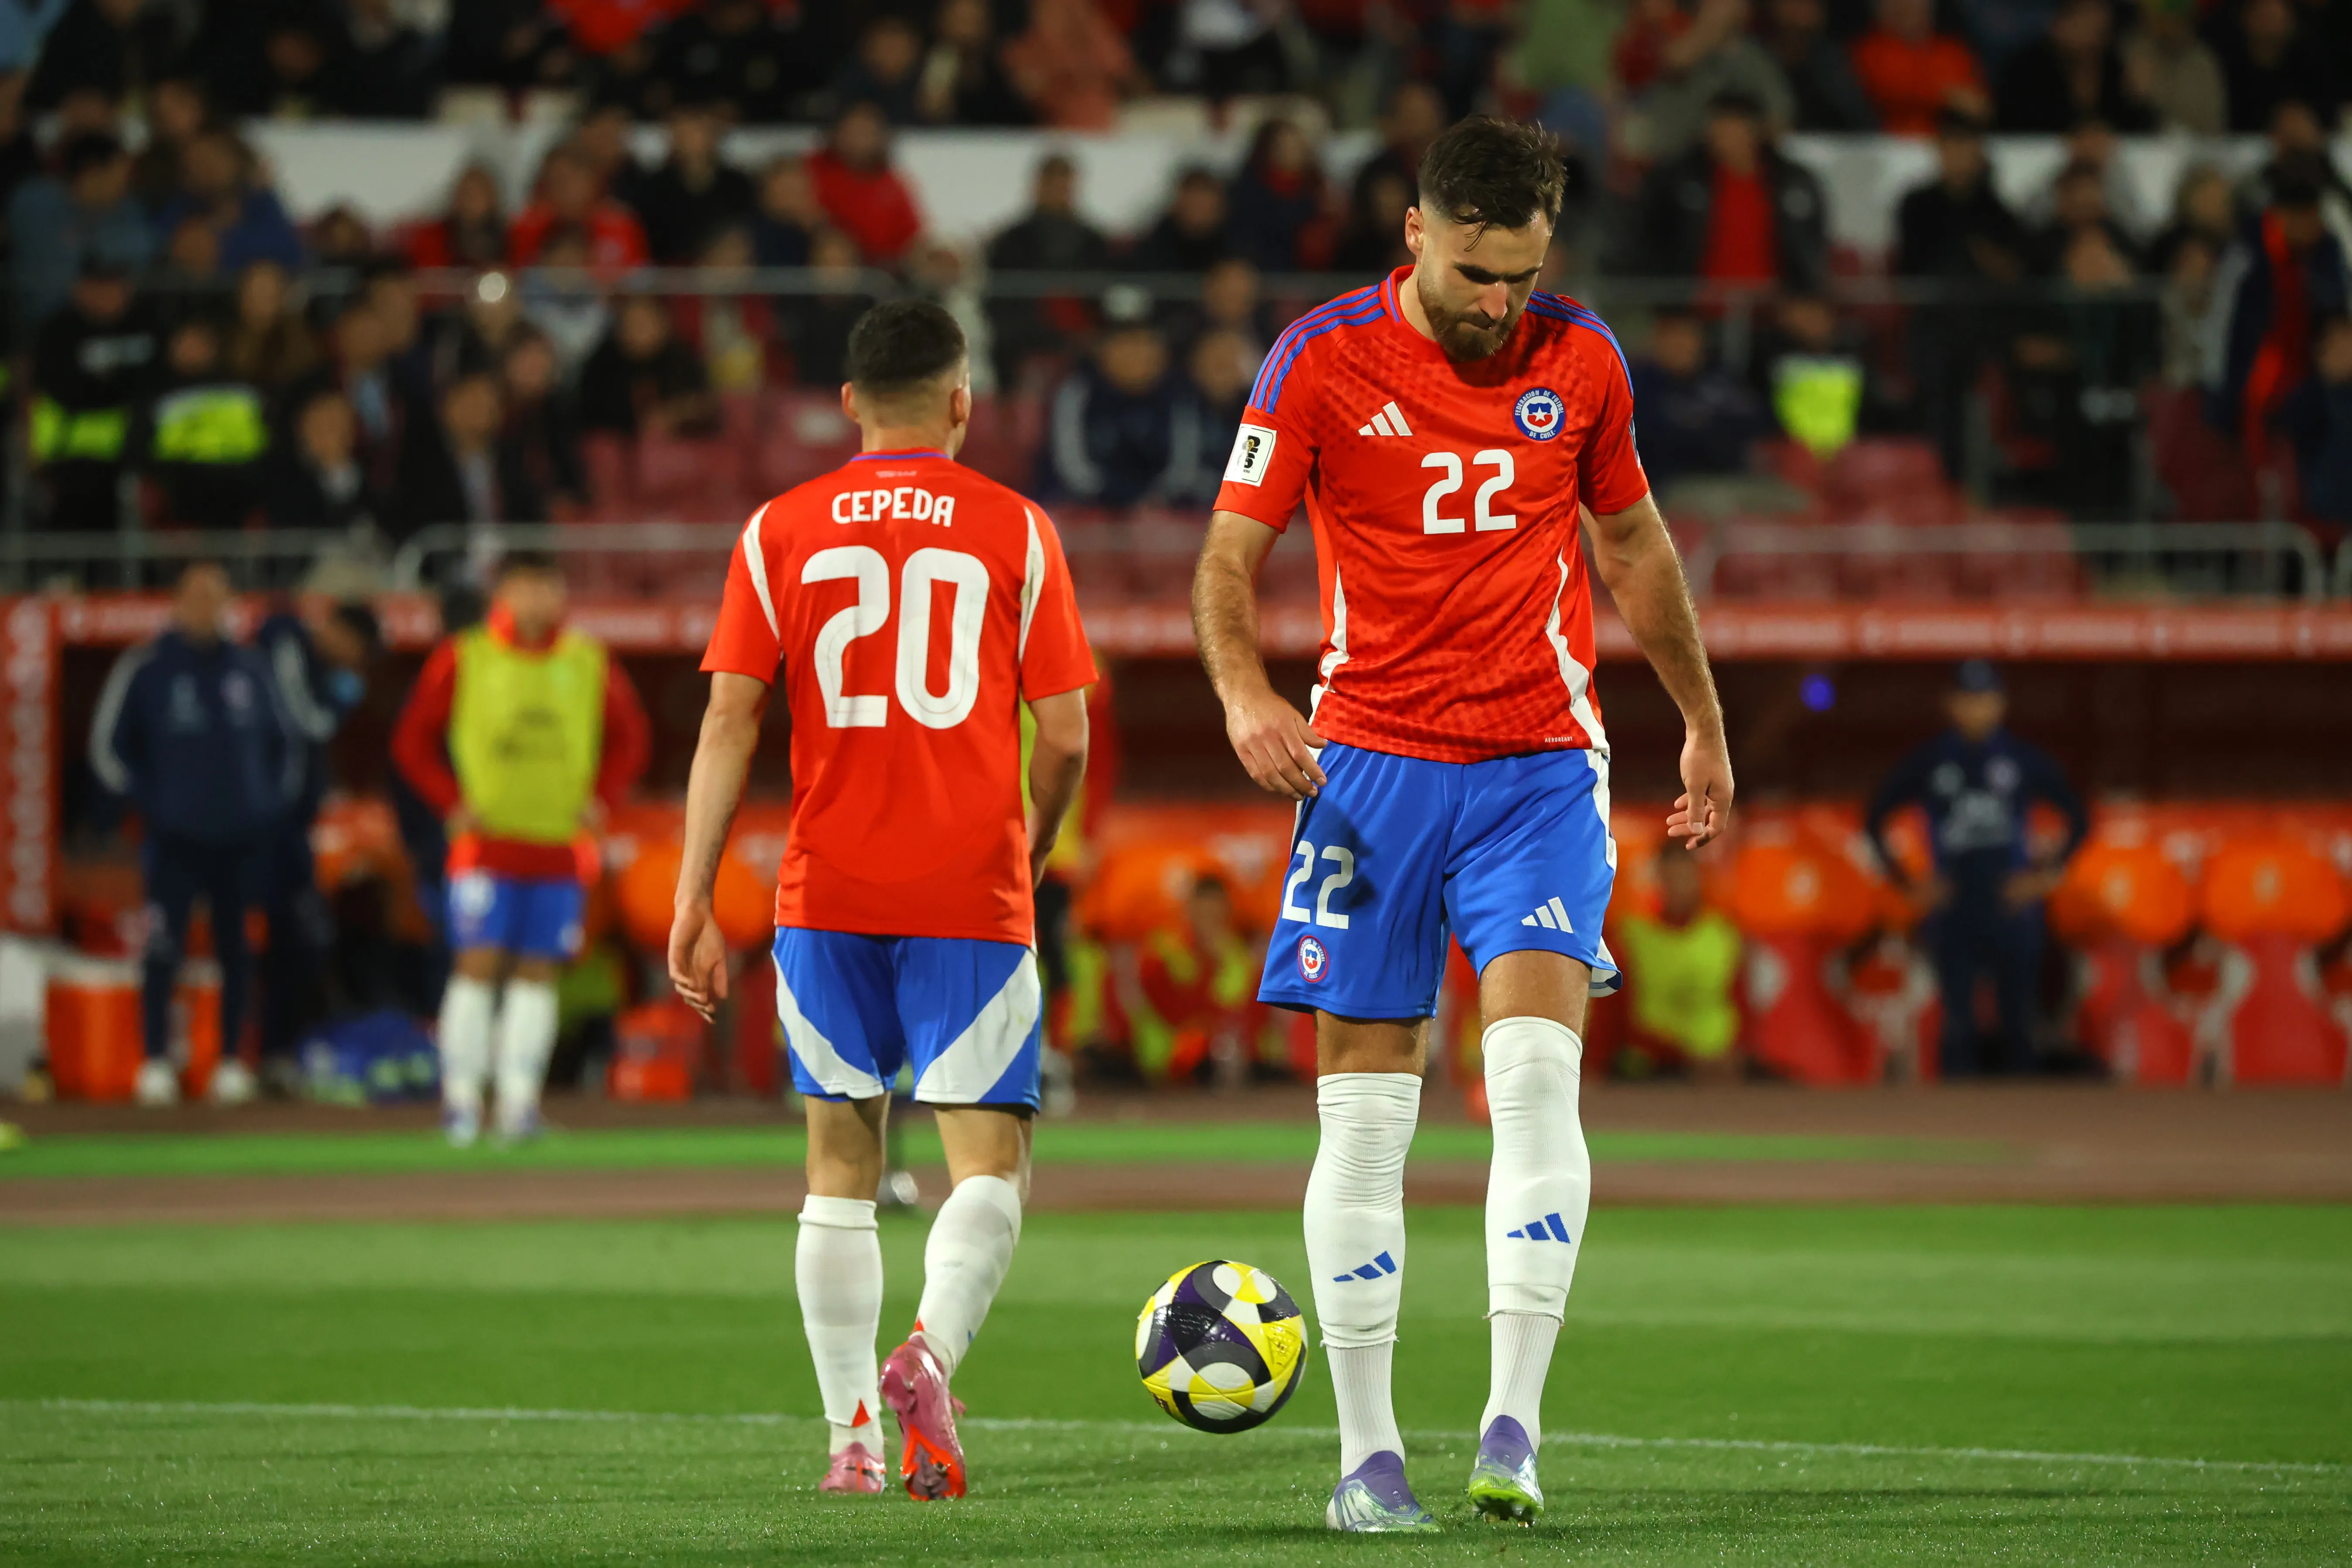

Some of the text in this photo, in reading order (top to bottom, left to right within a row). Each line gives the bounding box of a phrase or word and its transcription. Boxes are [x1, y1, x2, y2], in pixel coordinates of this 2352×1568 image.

[1515, 390, 1540, 416] FEDERACION
[1551, 395, 1564, 415] FUTBOL
[1540, 430, 1556, 439] CHILE
[832, 487, 955, 527] CEPEDA
[1421, 449, 1516, 534] 22
[801, 545, 989, 729] 20
[1282, 840, 1354, 929] 22
